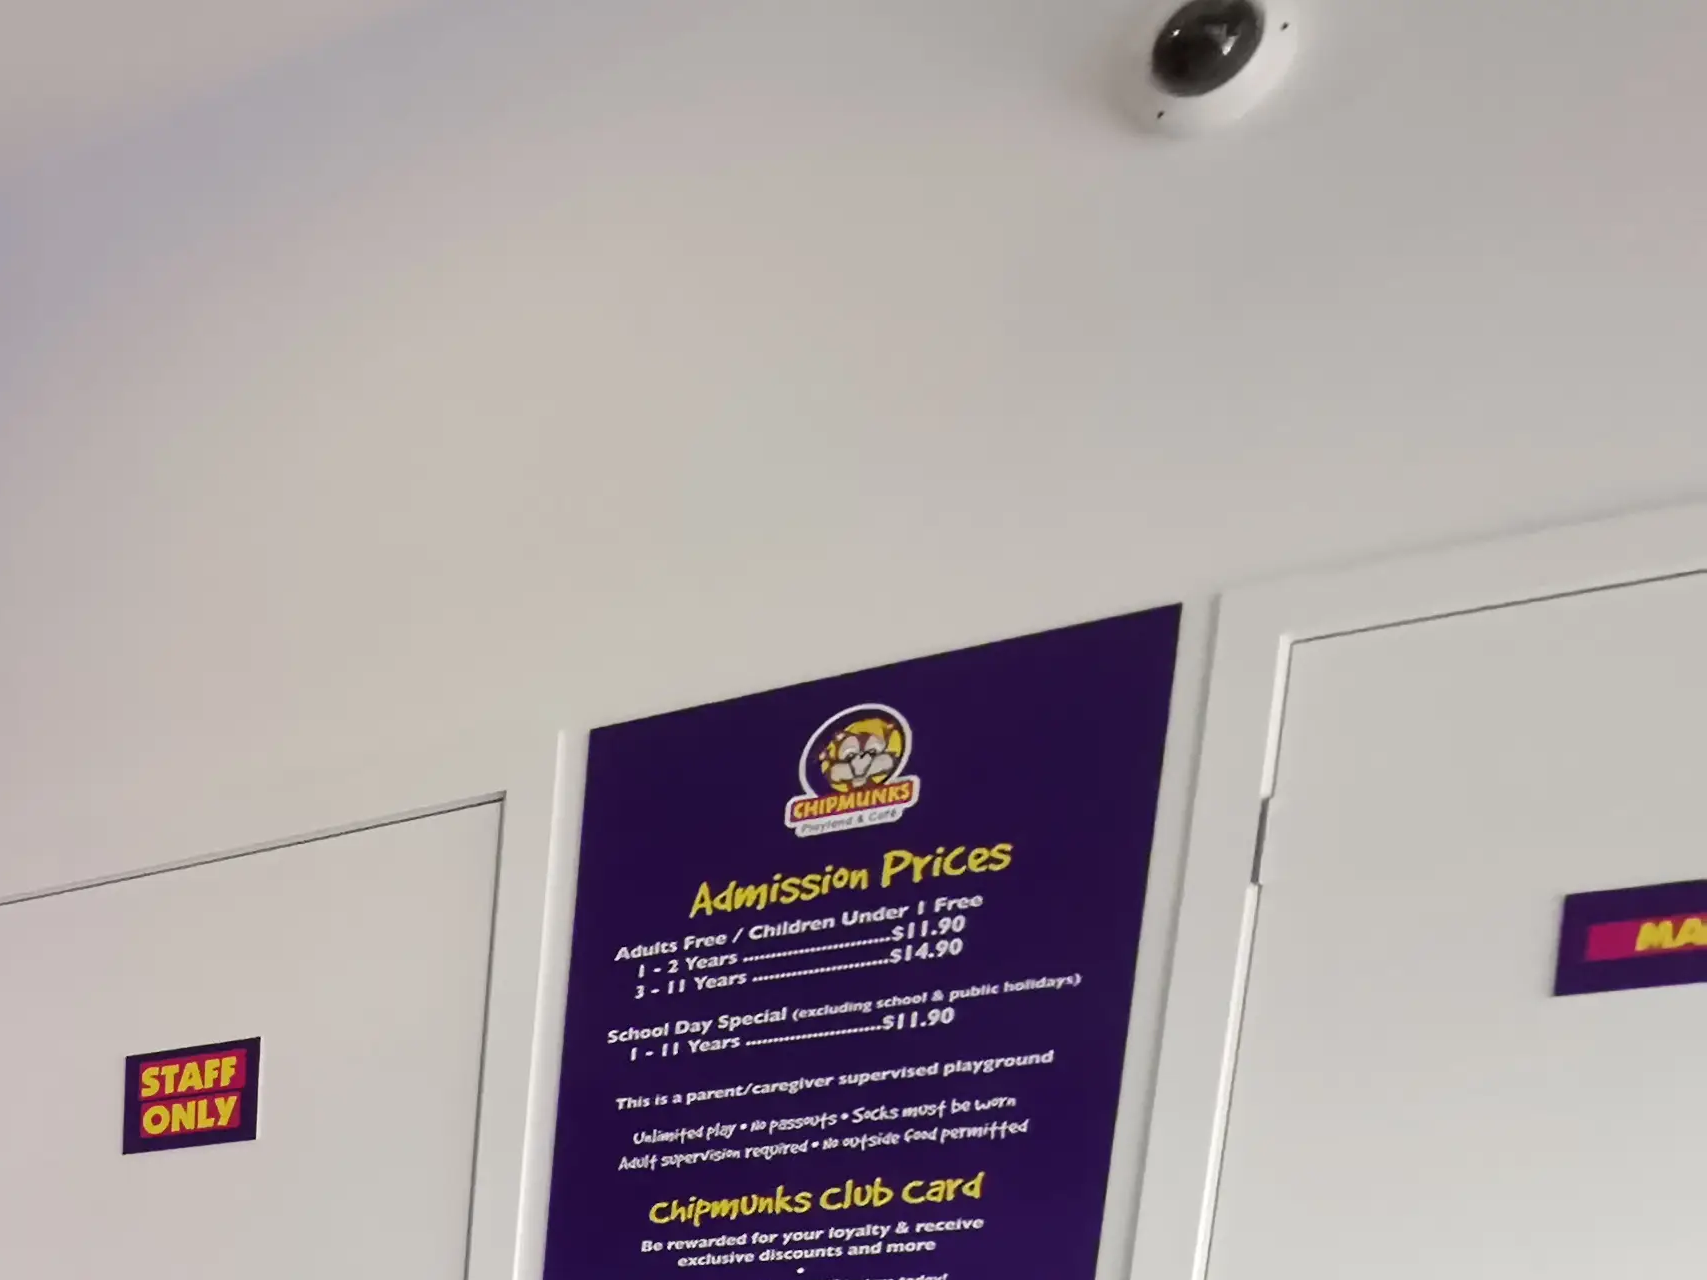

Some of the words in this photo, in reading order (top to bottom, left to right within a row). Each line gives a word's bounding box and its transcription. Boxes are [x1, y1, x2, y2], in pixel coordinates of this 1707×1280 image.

[793, 782, 910, 819] CHIPMUNKS
[688, 865, 868, 919] Admission
[881, 841, 1014, 890] Prices
[614, 940, 678, 961] Adults
[683, 934, 727, 951] Free
[748, 917, 835, 940] Children
[841, 905, 909, 926] Under
[934, 895, 983, 913] Free
[1635, 917, 1707, 952] MA
[667, 959, 679, 973] 2
[686, 953, 737, 971] Years
[634, 985, 645, 999] 3
[667, 978, 685, 994] 11
[694, 973, 747, 990] Years
[607, 1022, 669, 1044] School
[675, 1019, 713, 1035] Day
[717, 1007, 787, 1031] Special
[792, 1000, 873, 1021] (excluding
[876, 992, 927, 1009] school
[948, 984, 999, 1002] public
[1003, 972, 1082, 992] holidays)
[662, 1042, 679, 1057] 11
[688, 1036, 740, 1053] Years
[141, 1056, 237, 1098] STAFF
[615, 1097, 650, 1110] This
[654, 1094, 668, 1106] is
[672, 1093, 682, 1104] a
[686, 1076, 834, 1105] parent/caregiver
[838, 1062, 939, 1086] supervised
[943, 1049, 1055, 1077] playground
[142, 1095, 238, 1135] ONLY
[633, 1125, 704, 1144] Unlimited
[706, 1122, 737, 1141] play
[769, 1112, 837, 1135] passouts
[851, 1105, 899, 1123] Socks
[902, 1100, 946, 1118] must
[951, 1098, 971, 1114] be
[974, 1096, 1016, 1111] worn
[617, 1154, 658, 1171] Adult
[661, 1148, 741, 1168] supervision
[744, 1139, 809, 1160] required
[842, 1132, 900, 1151] outside
[940, 1118, 1030, 1145] permitted
[648, 1184, 813, 1227] Chipmunks
[641, 1240, 663, 1253] Be
[666, 1233, 747, 1250] rewarded
[751, 1232, 778, 1245] for
[782, 1229, 824, 1246] your
[828, 1223, 891, 1241] loyalty
[895, 1221, 910, 1234] &
[915, 1217, 985, 1233] receive
[677, 1251, 755, 1267] exclusive
[758, 1245, 843, 1262] discounts
[847, 1241, 883, 1256] and
[886, 1240, 936, 1253] more
